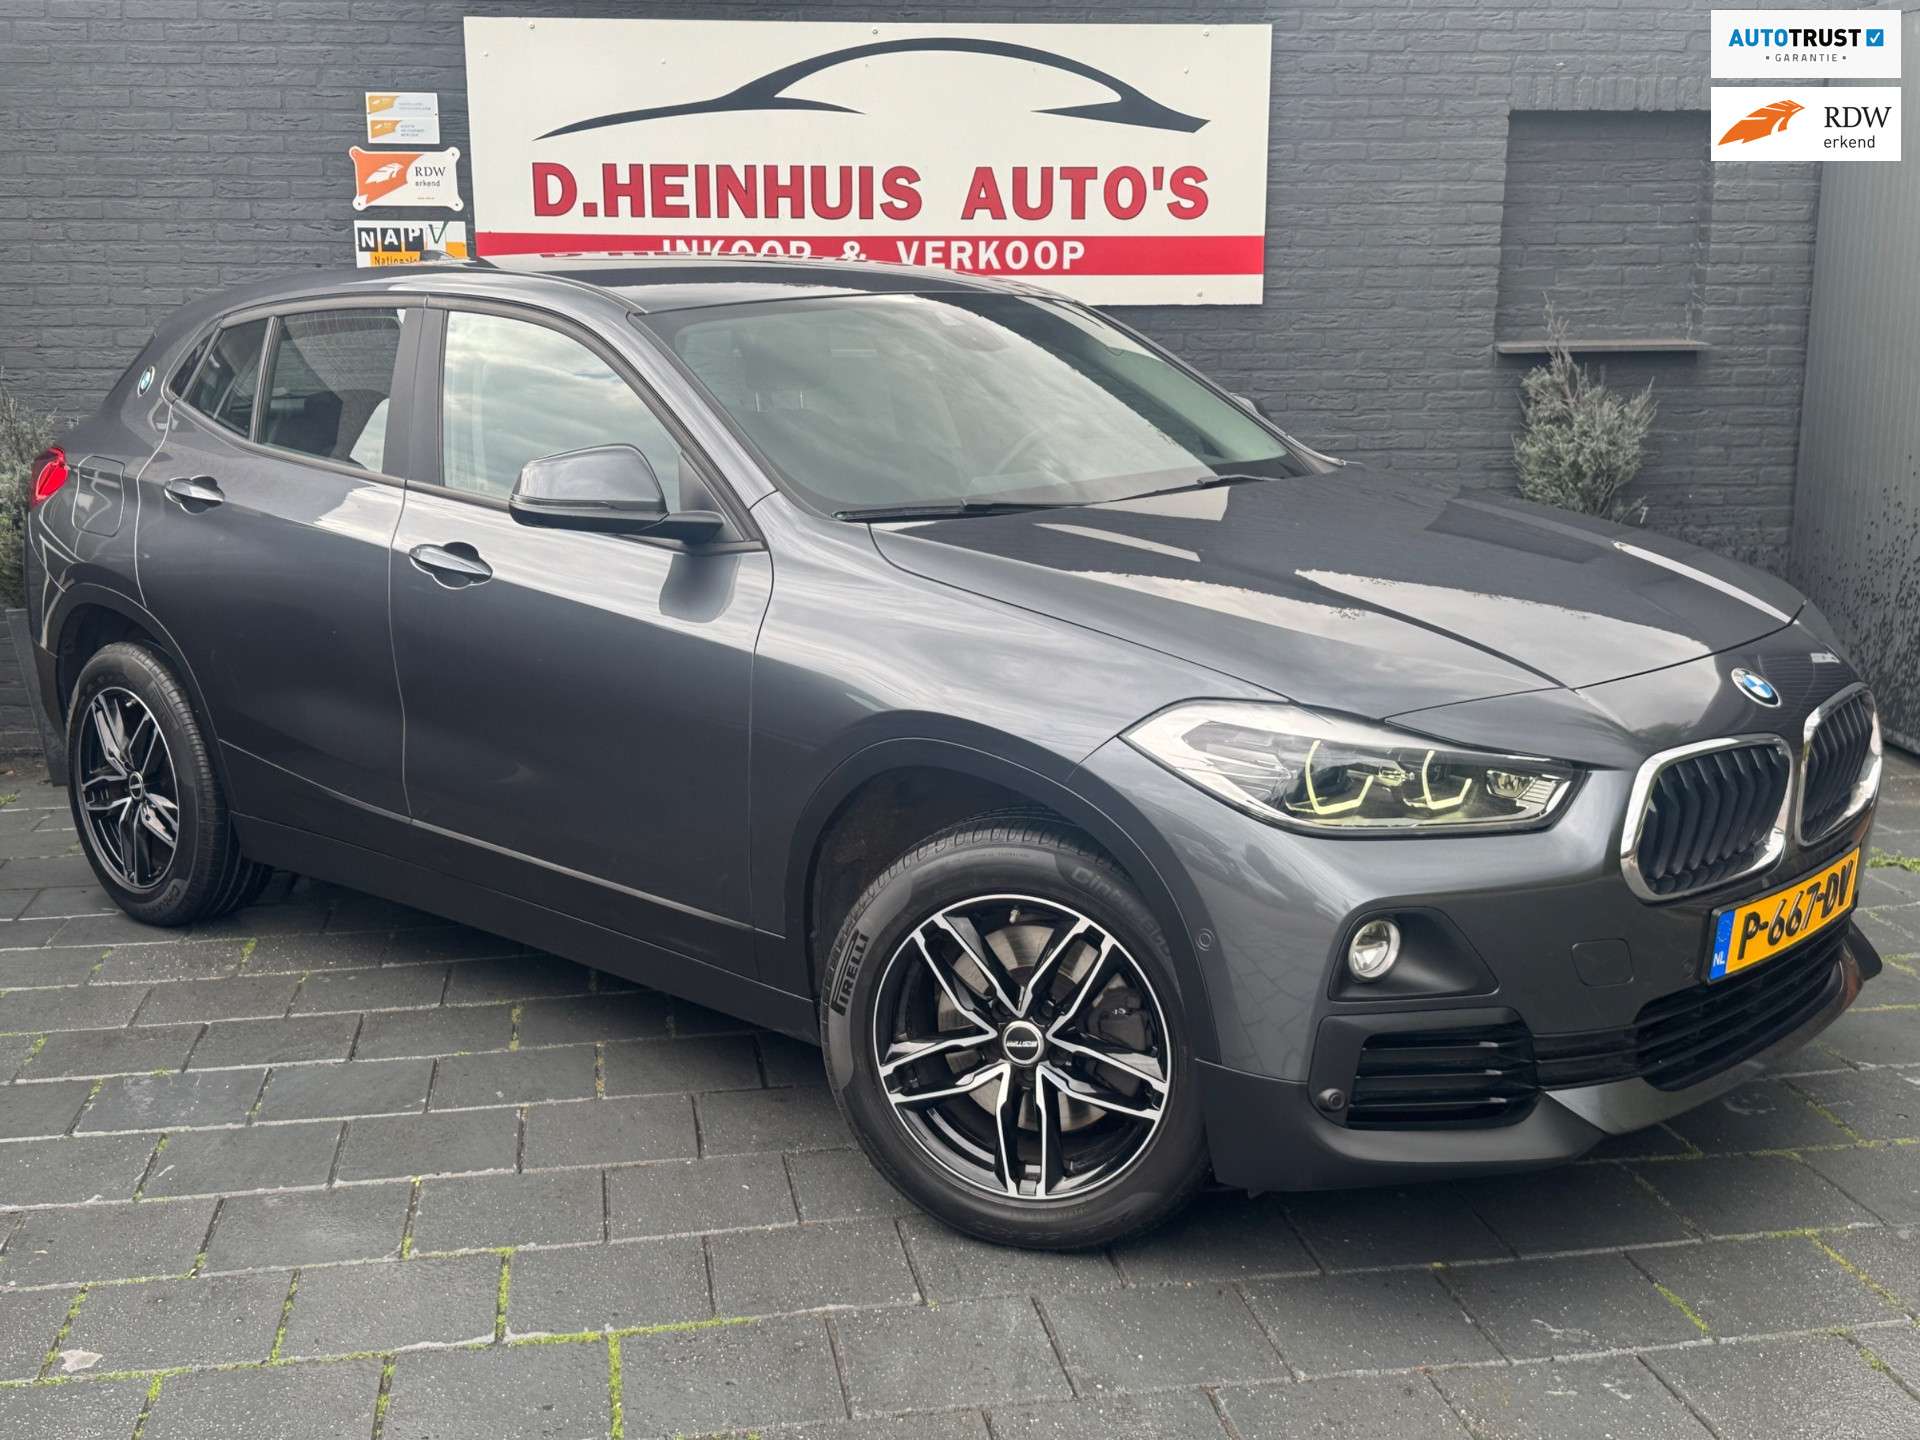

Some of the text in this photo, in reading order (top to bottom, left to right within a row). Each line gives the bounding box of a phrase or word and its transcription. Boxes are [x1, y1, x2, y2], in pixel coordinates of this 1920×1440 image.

[414, 165, 447, 177] RDW
[415, 179, 441, 188] erkend
[532, 162, 1209, 221] D.HEINHUIS AUTO'S
[896, 240, 1086, 271] VERKOOP
[1737, 859, 1854, 961] P-667-DV
[830, 927, 870, 1016] PIRELLI
[1712, 951, 1725, 967] NL
